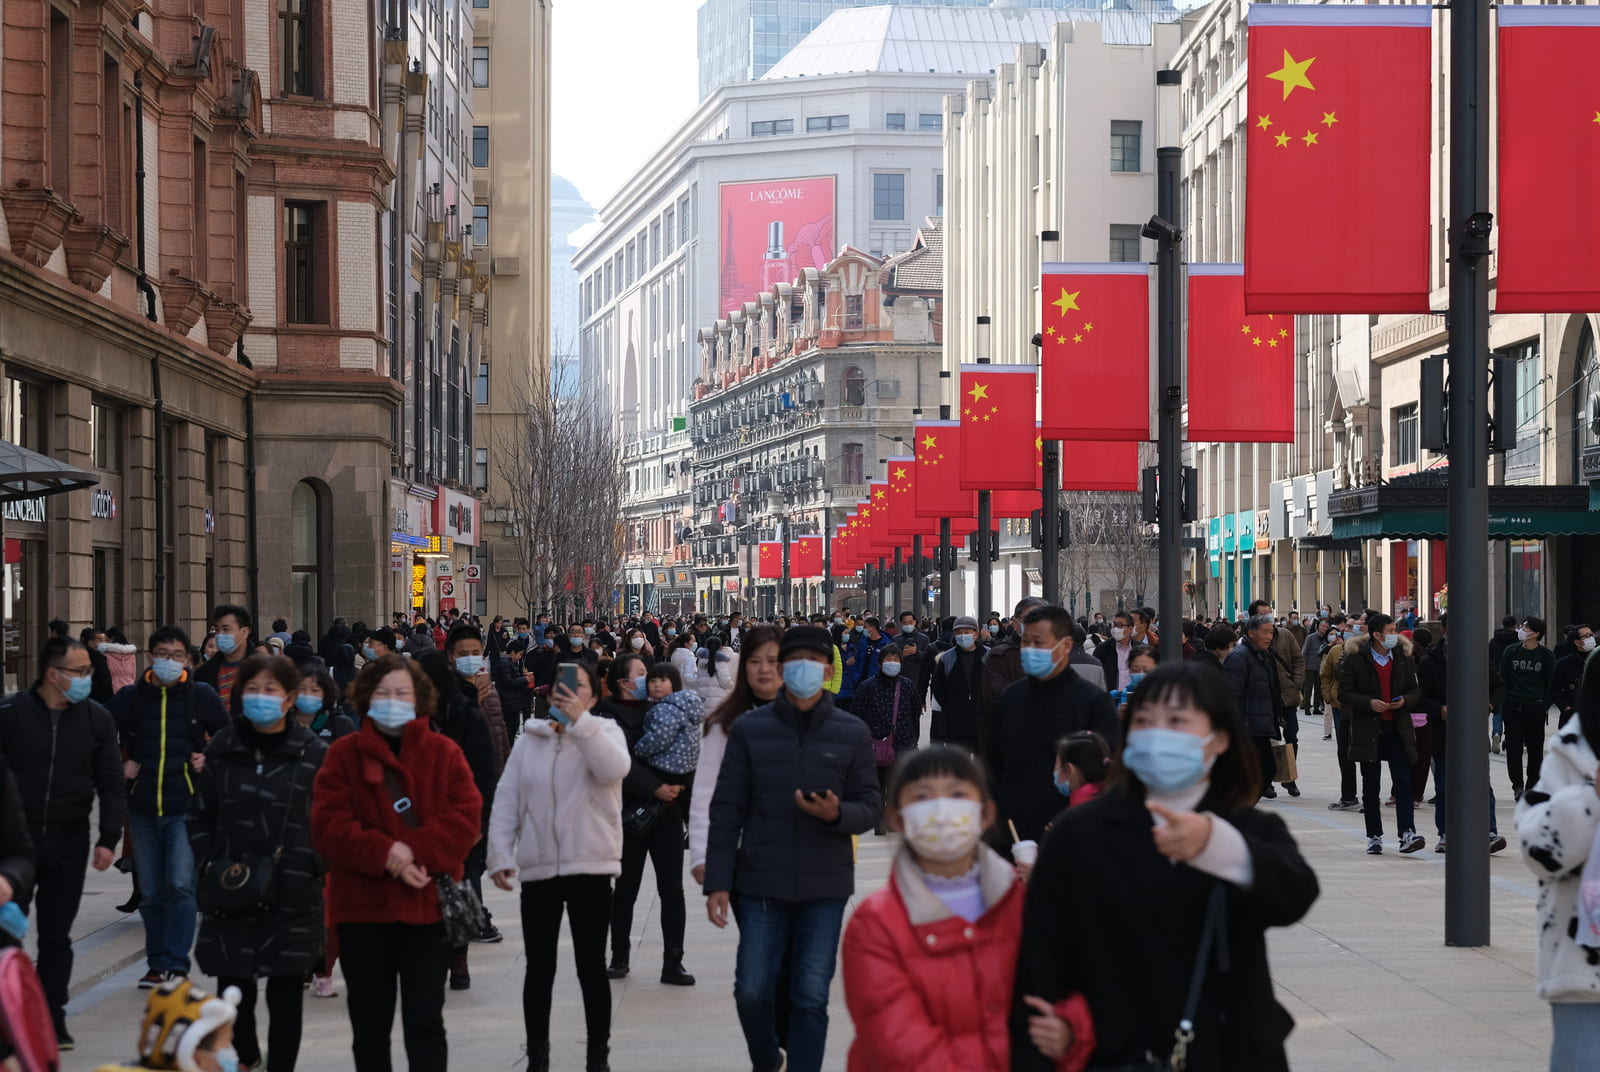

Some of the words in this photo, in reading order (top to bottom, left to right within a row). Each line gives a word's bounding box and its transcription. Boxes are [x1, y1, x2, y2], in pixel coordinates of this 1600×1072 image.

[750, 187, 804, 201] LANCÔME
[2, 495, 46, 522] LANCPAIN
[91, 488, 112, 519] watch
[1511, 660, 1542, 672] POLO
